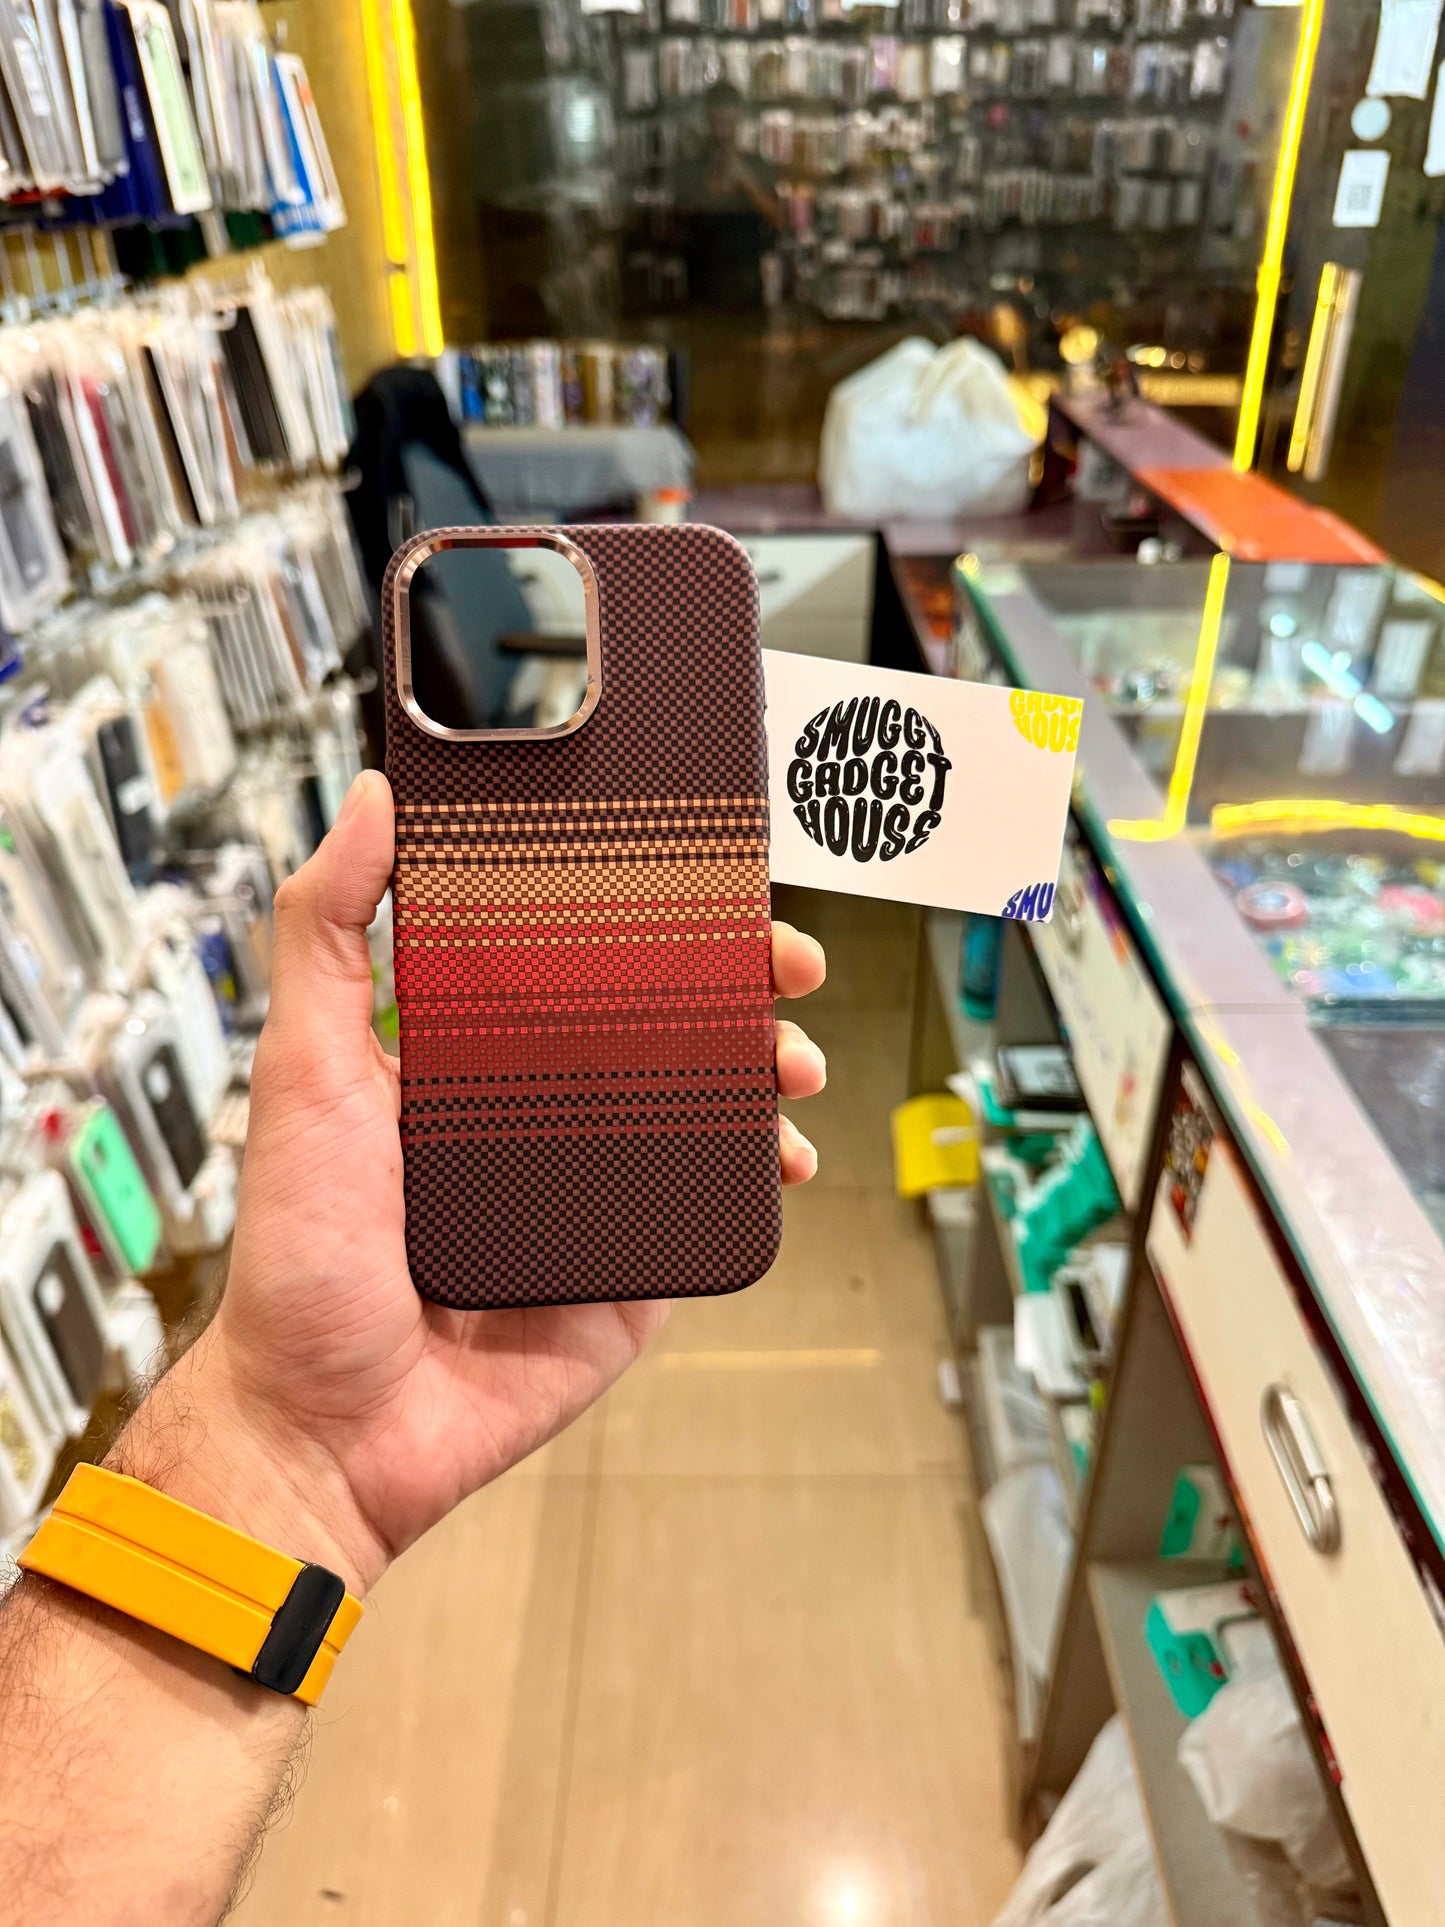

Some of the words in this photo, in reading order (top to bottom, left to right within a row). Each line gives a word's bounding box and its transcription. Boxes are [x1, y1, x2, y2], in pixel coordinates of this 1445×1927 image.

[795, 696, 944, 761] SMUGGY
[787, 750, 952, 811] GADGET
[793, 796, 941, 862] HOUSE
[1001, 882, 1054, 921] SMU
